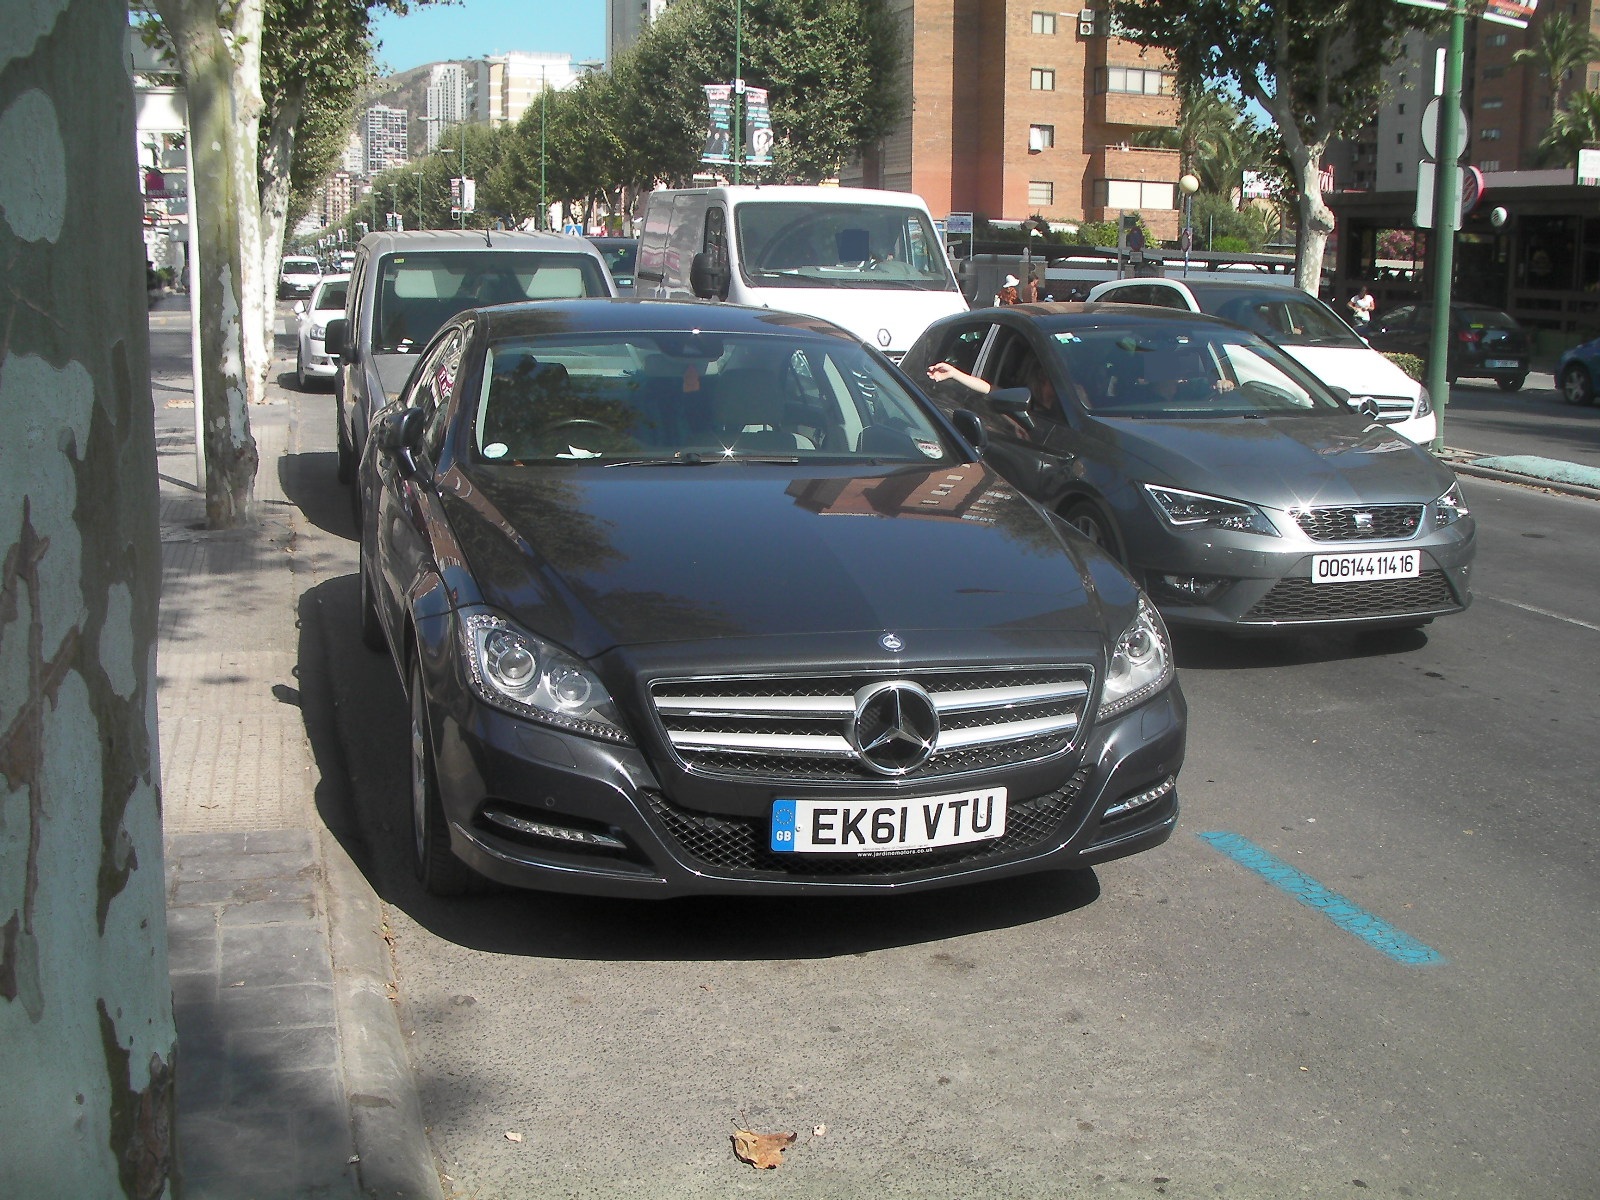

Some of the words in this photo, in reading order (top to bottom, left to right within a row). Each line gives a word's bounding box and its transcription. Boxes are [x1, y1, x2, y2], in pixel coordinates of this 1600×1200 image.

[811, 807, 908, 845] EK61
[923, 796, 994, 840] VTU
[776, 830, 792, 842] GB
